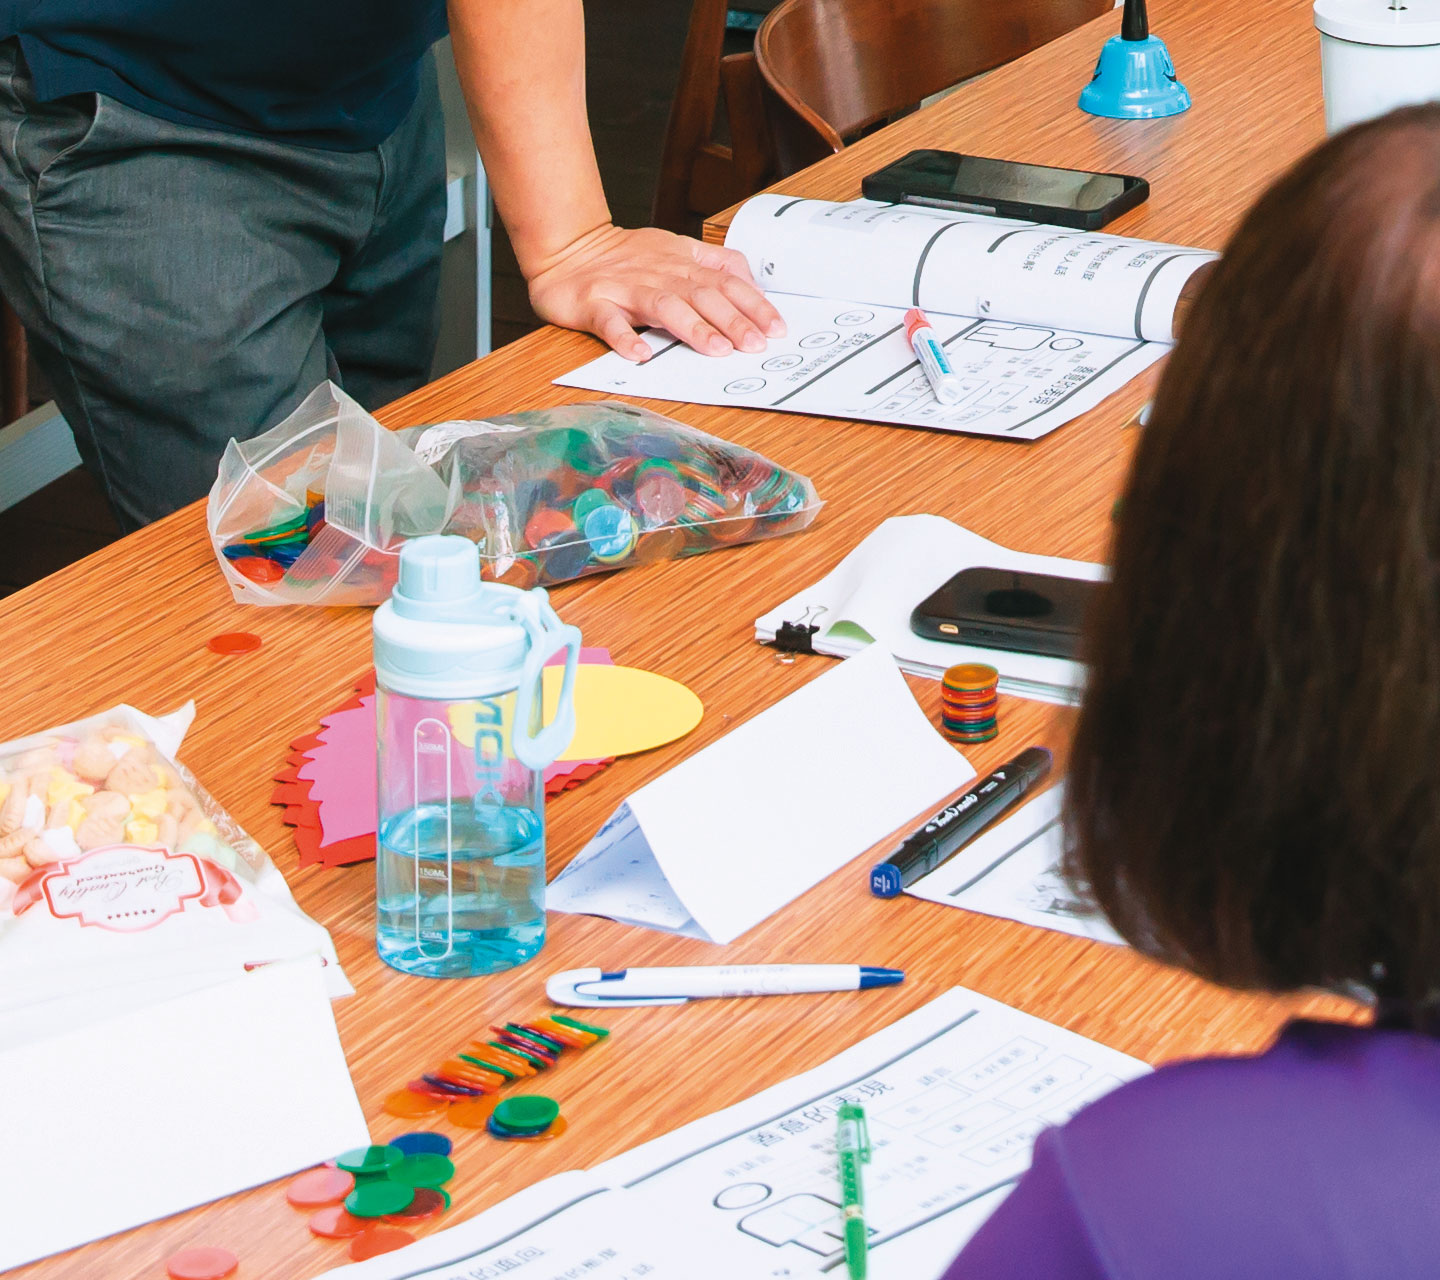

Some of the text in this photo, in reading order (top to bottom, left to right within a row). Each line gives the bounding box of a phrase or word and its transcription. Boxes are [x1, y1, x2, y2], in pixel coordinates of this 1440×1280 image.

[747, 1078, 896, 1149] 善意的表現
